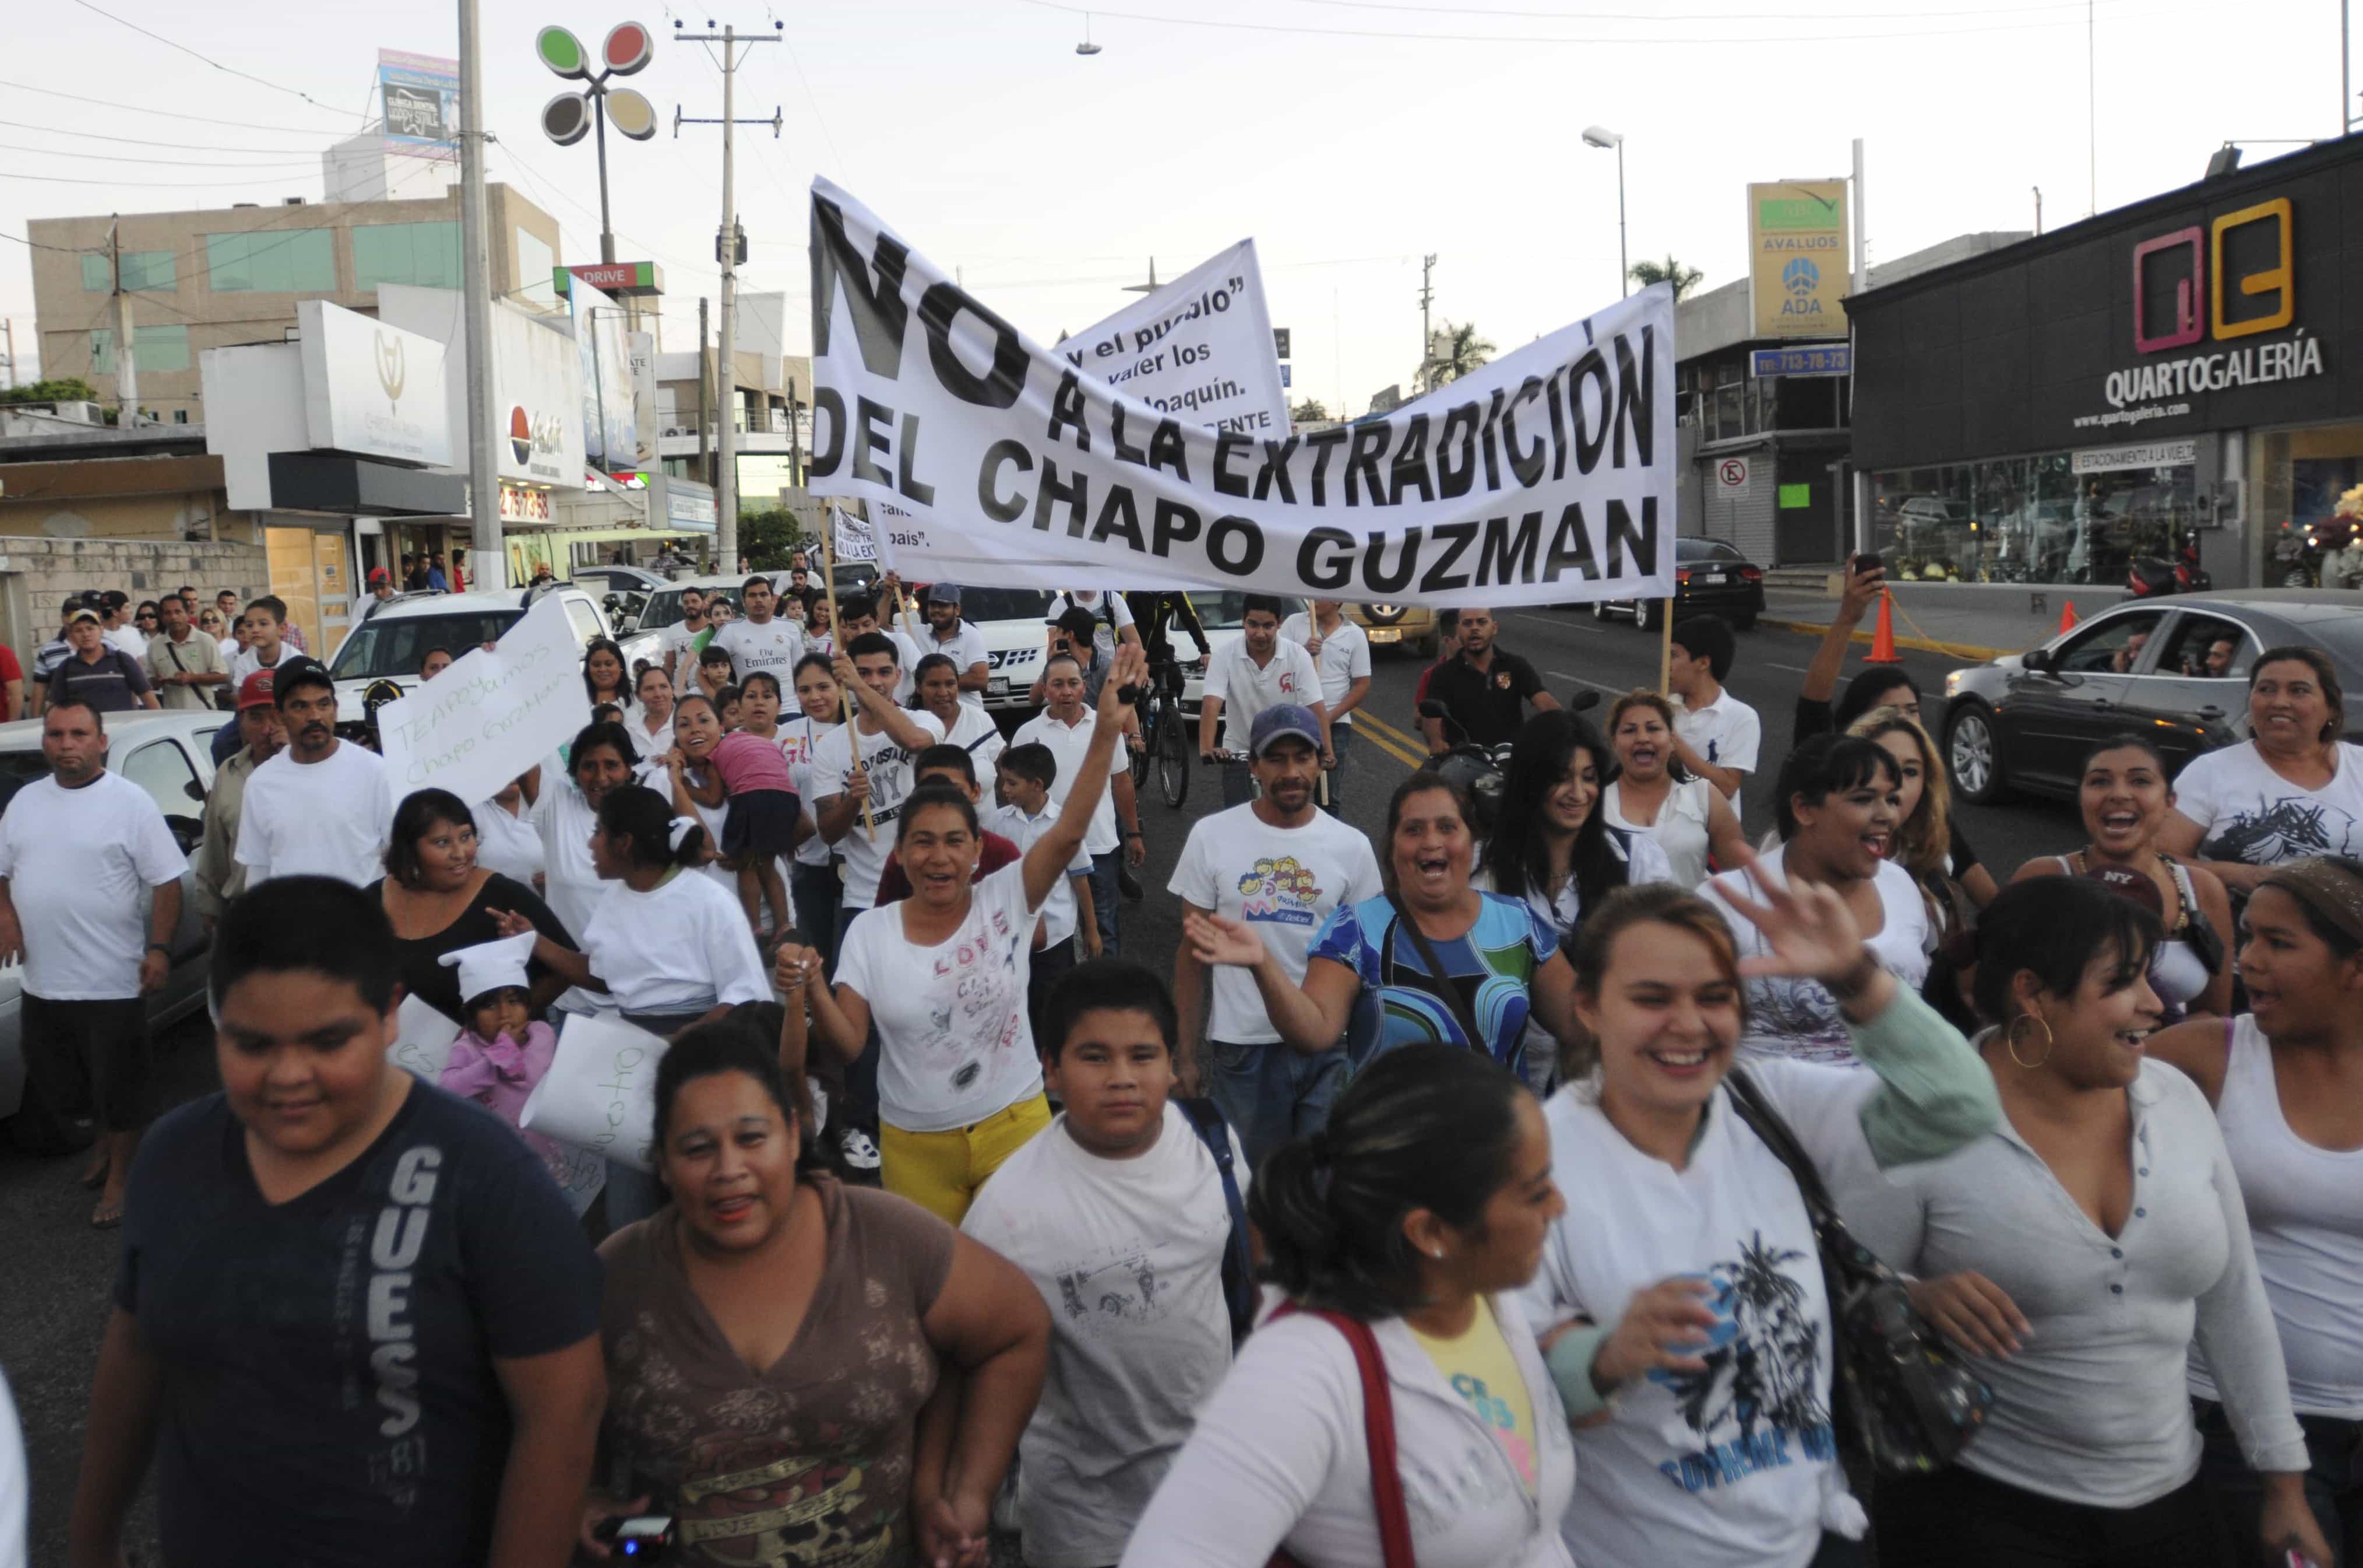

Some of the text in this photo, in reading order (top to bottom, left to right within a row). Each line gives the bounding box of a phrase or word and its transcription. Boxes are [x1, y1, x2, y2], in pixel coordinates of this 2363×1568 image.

[1763, 236, 1839, 249] AVALUOS
[584, 270, 625, 283] DRIVE
[1782, 298, 1823, 314] ADA
[811, 191, 1654, 507] NO A LA EXTRADICIÓN
[1096, 332, 1124, 357] el
[1172, 343, 1210, 367] los
[2105, 327, 2323, 408] QUARTOGALERÍA
[2074, 403, 2190, 428] www.quartogaleria.com
[811, 386, 1657, 593] DEL CHAPO GUZMAN
[745, 657, 788, 668] Emirates
[759, 649, 773, 657] Fly
[2103, 871, 2133, 885] NY
[367, 1145, 443, 1437] GUESS
